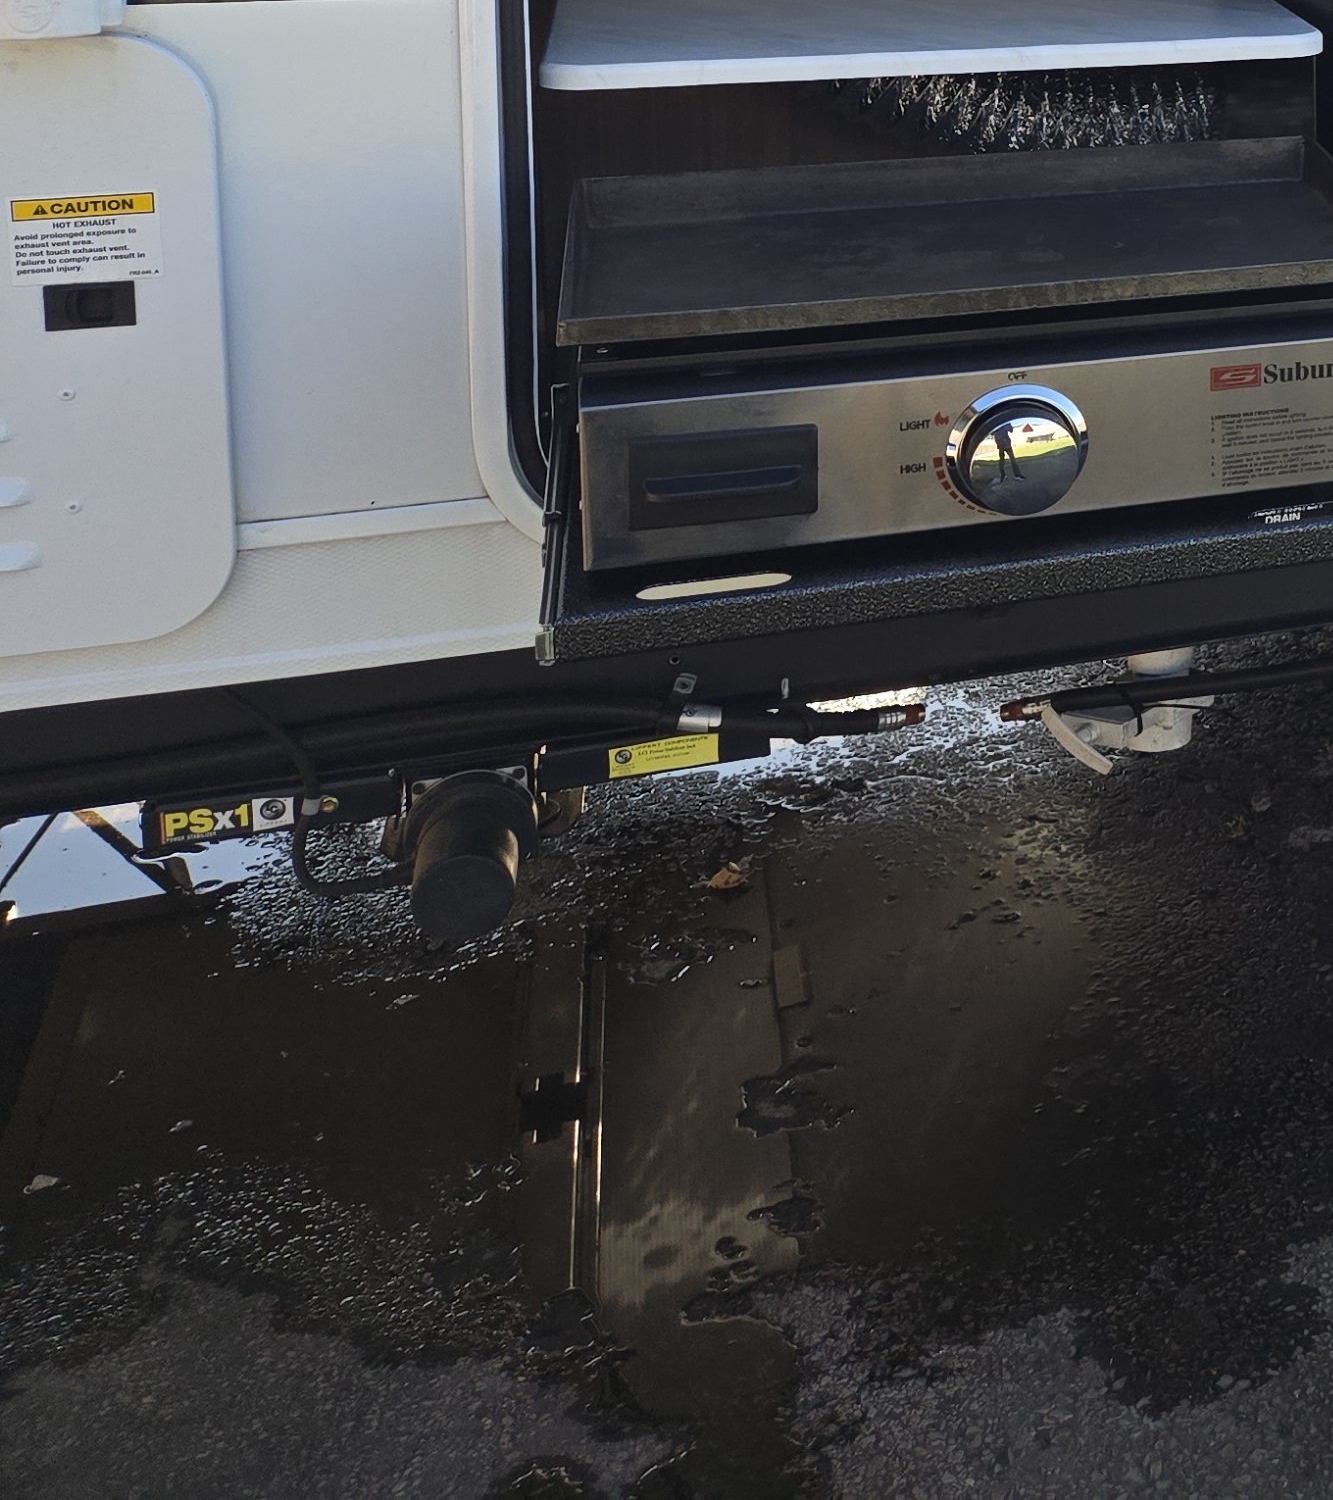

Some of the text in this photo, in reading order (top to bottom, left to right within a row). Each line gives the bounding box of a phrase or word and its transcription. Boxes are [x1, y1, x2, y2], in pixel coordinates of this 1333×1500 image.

[50, 199, 134, 214] CAUTION
[74, 219, 116, 228] EXHAUST
[14, 233, 38, 241] Avoid
[40, 231, 84, 240] prolonged
[86, 228, 126, 237] exposure
[46, 248, 70, 256] touch
[72, 246, 106, 254] exhaust
[16, 259, 46, 267] Failure
[59, 256, 90, 264] comply
[110, 252, 135, 260] result
[16, 265, 84, 276] personal injury.
[1008, 371, 1028, 381] OFF
[899, 419, 931, 432] LIGHT
[900, 462, 927, 475] HIGH
[1265, 512, 1301, 524] DRAIN
[165, 803, 249, 837] PSx1
[187, 831, 217, 840] STABILIZER
